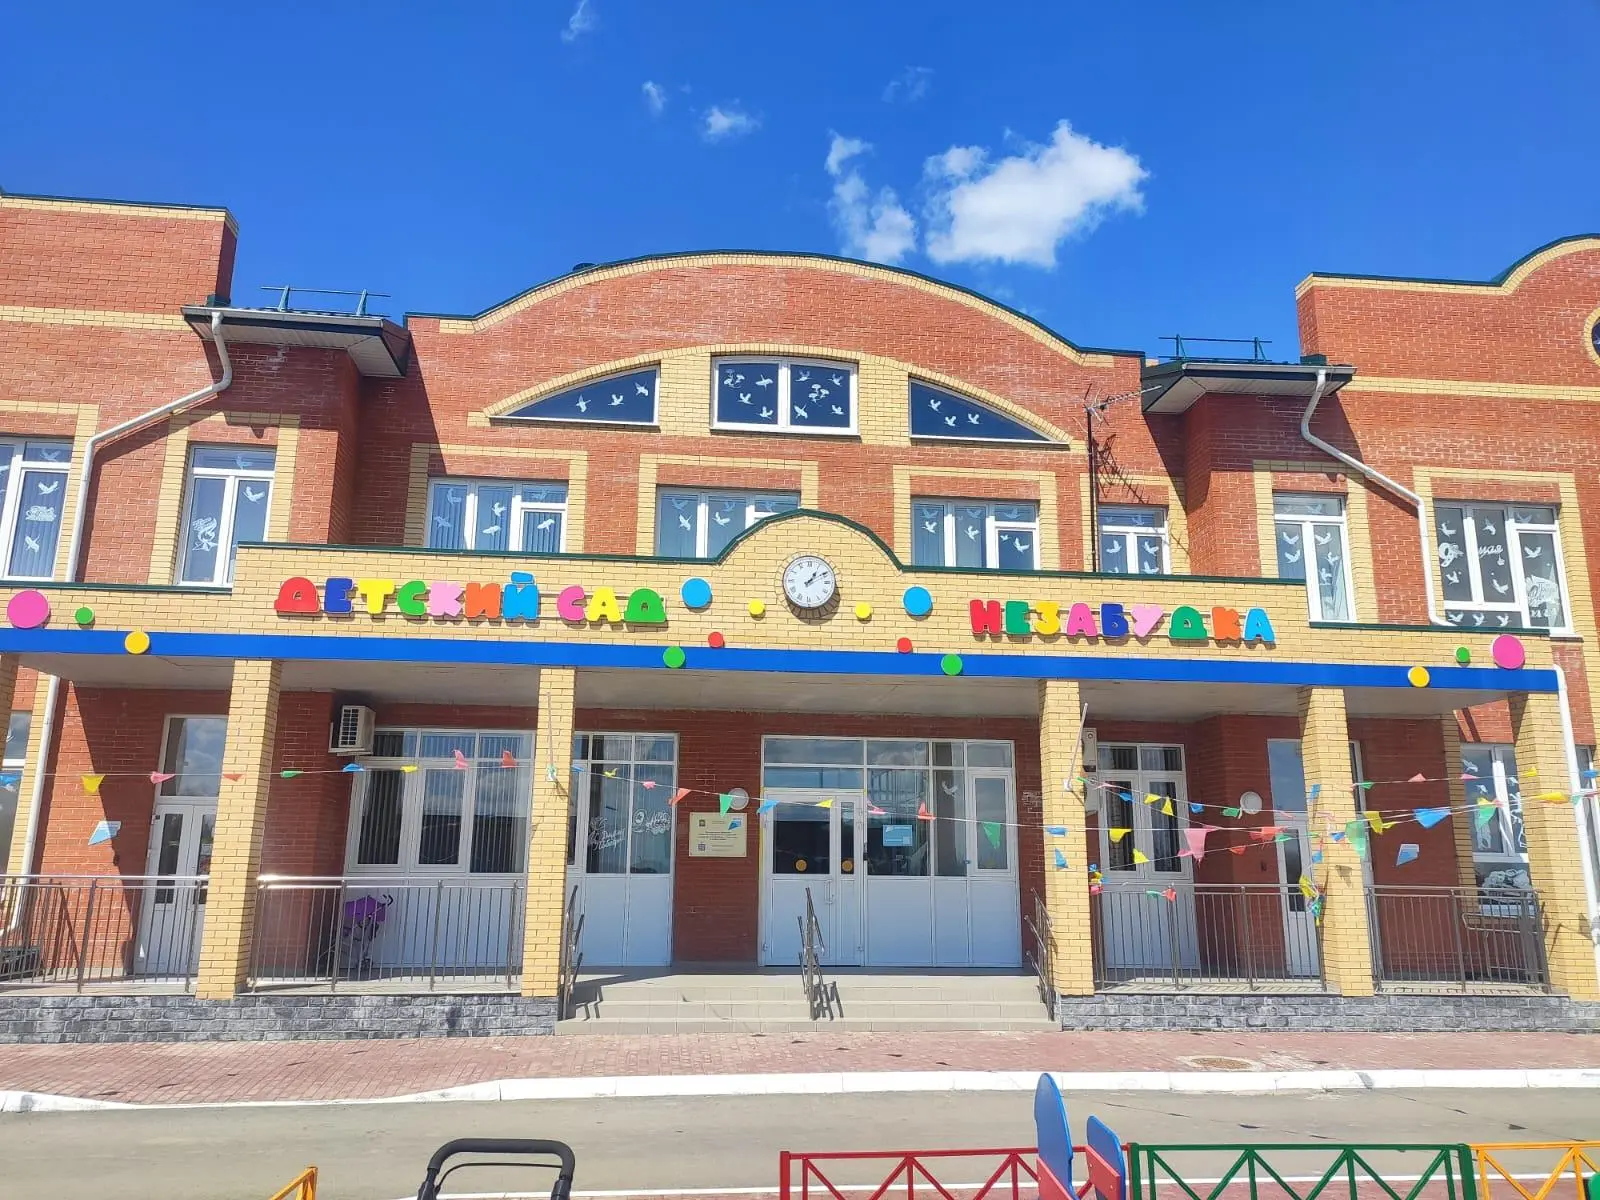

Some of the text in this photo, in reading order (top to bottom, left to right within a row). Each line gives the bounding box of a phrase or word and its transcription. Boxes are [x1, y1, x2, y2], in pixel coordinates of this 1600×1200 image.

[274, 571, 667, 623] ДЕТСКИЙ САД
[969, 599, 1276, 642] НЕЗАБУДКА
